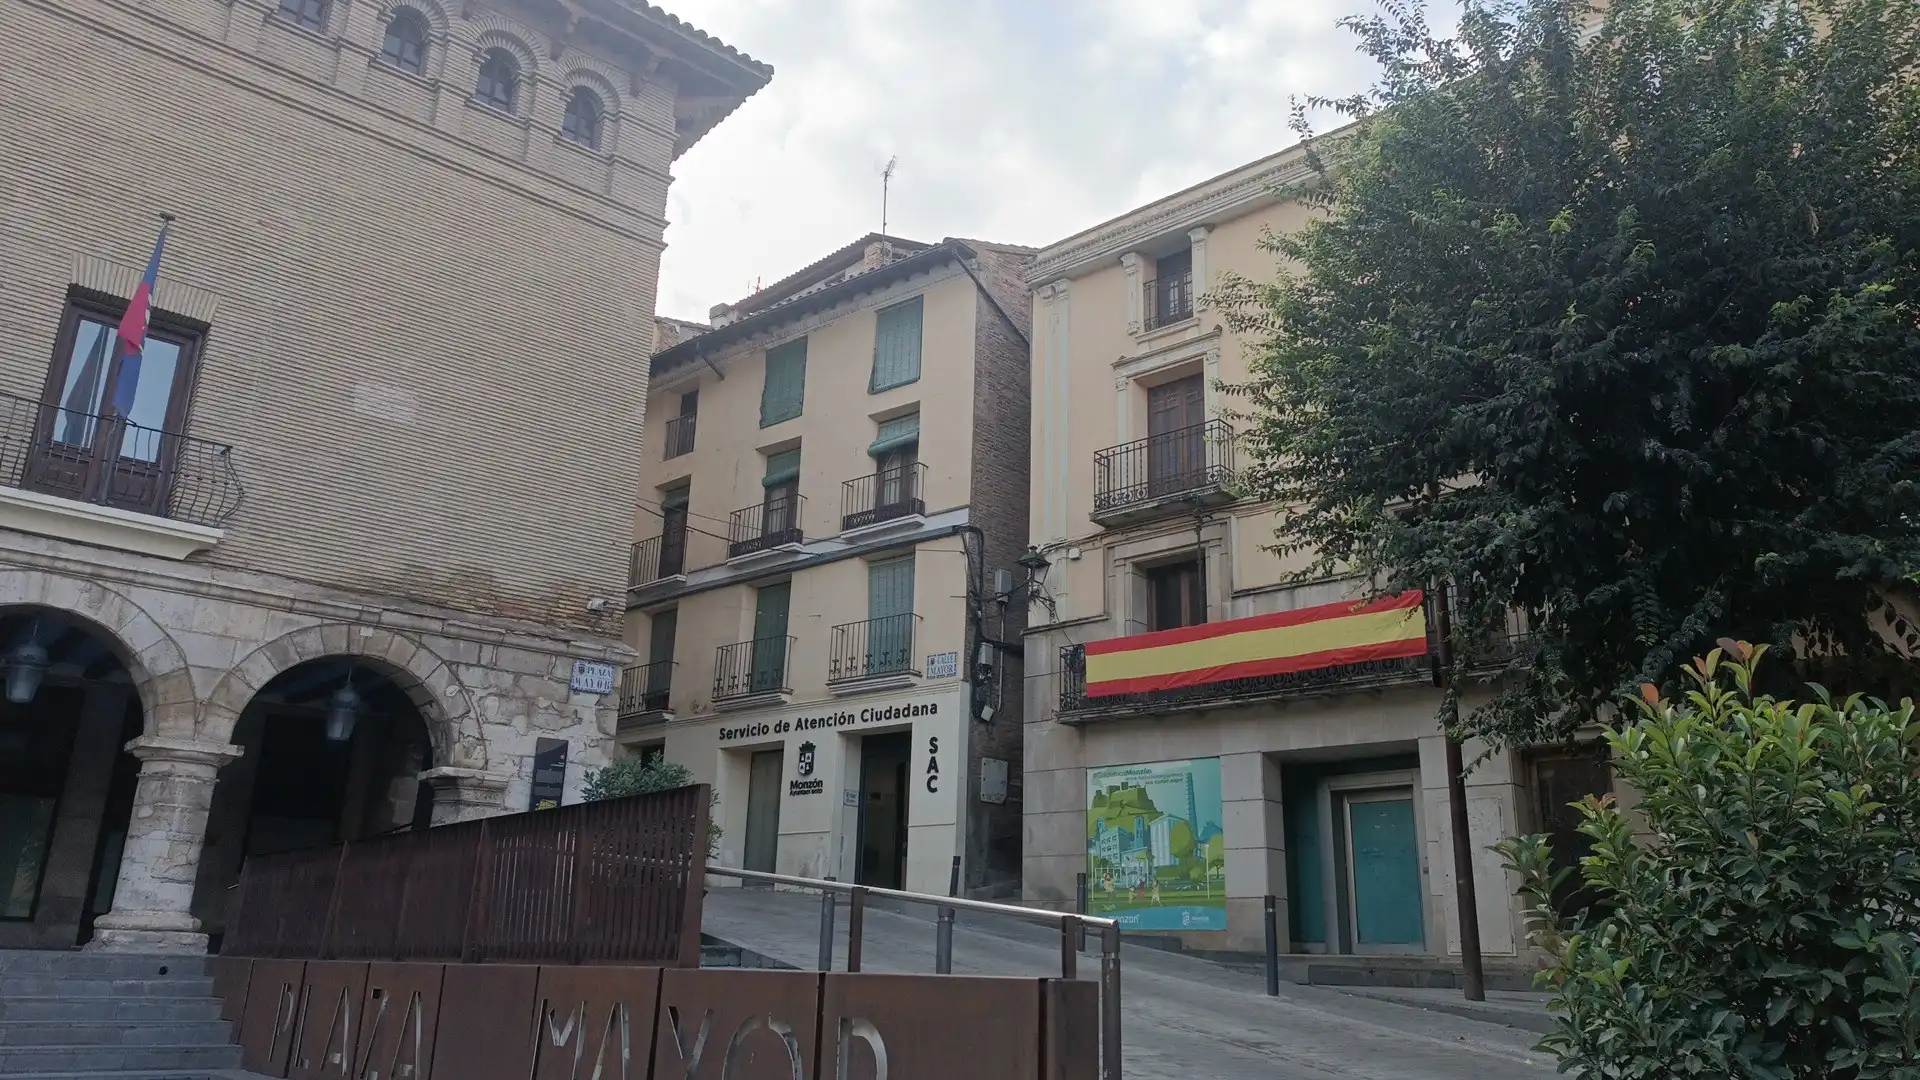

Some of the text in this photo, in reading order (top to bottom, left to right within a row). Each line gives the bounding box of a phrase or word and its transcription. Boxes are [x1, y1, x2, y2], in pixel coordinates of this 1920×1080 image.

[937, 655, 954, 665] CALLE
[587, 666, 611, 677] PLAZA
[930, 664, 954, 676] MAYOR
[574, 677, 611, 691] MAYOR
[719, 703, 938, 741] Servicio de Atención Ciudadana
[790, 778, 823, 790] Monzón
[789, 788, 823, 797] Ayuntamento
[268, 982, 422, 1080] PLAZA
